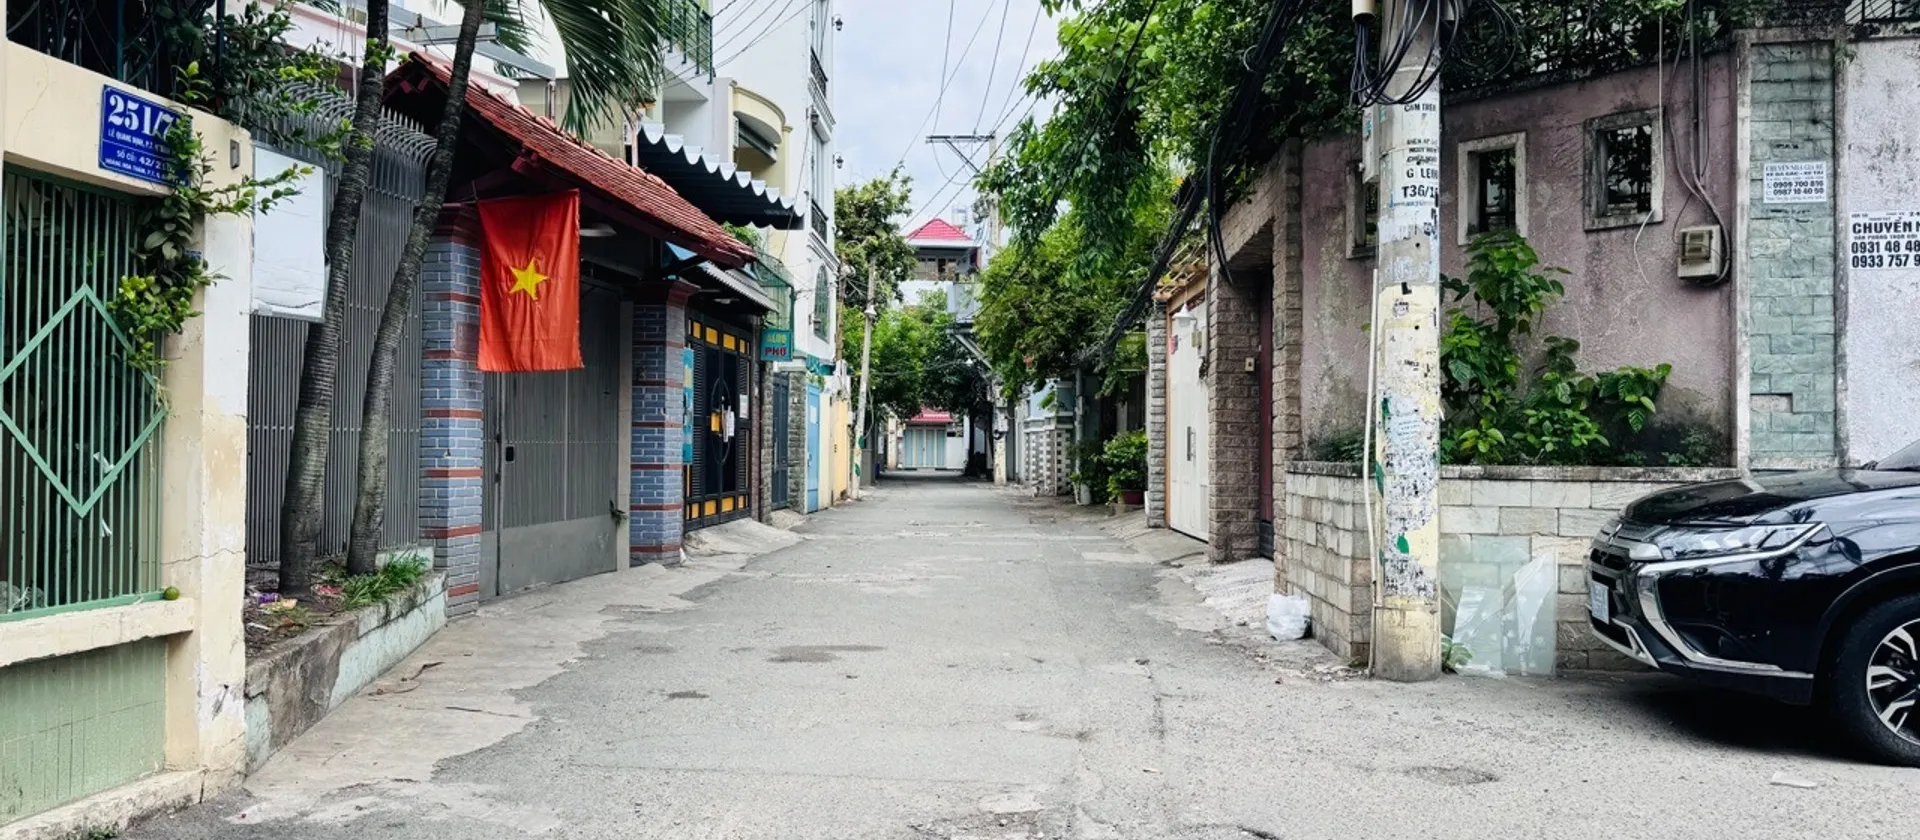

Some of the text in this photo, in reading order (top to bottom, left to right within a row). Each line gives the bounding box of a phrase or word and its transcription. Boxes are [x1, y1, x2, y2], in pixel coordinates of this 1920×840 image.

[1852, 217, 1912, 234] CHUYỂN
[1851, 241, 1880, 254] 0931
[1884, 240, 1900, 253] 48
[1852, 254, 1884, 268] 0933
[1887, 254, 1910, 267] 757
